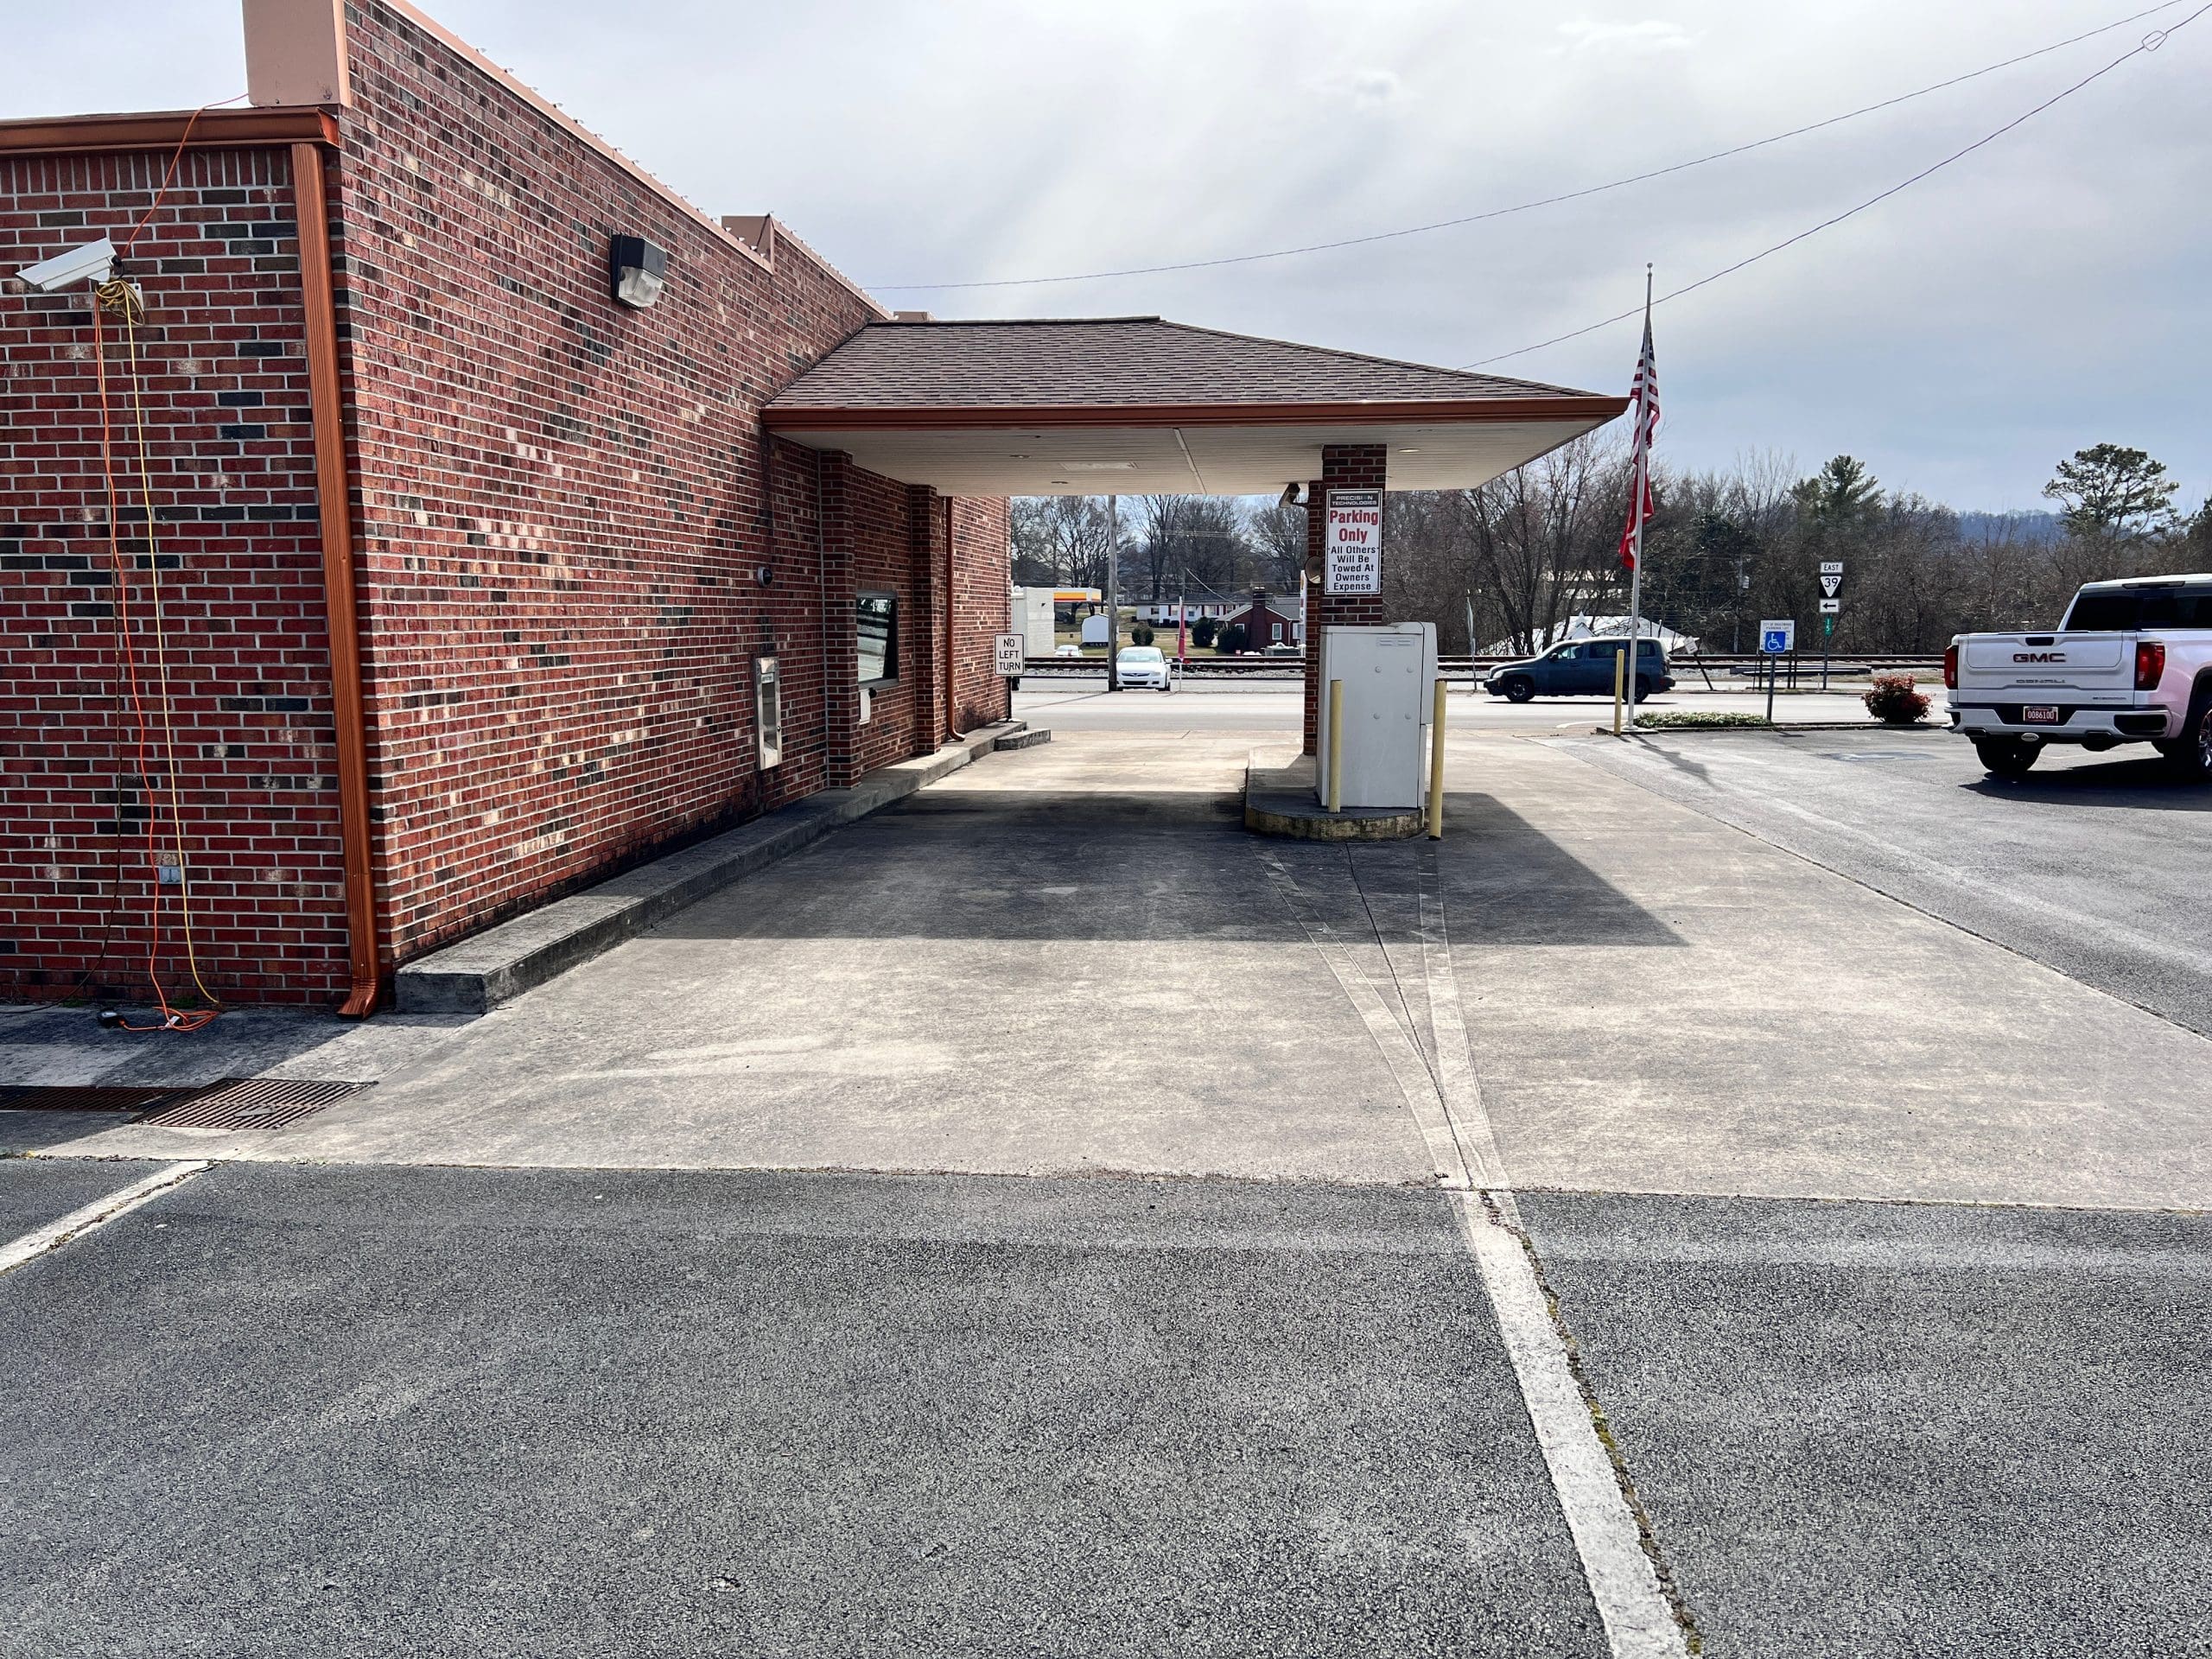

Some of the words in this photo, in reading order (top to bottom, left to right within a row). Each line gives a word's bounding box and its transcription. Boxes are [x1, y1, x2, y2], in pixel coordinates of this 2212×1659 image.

[1330, 510, 1378, 525] Parking
[1339, 528, 1368, 543] Only
[1346, 545, 1376, 554] Others
[1335, 573, 1370, 582] Owners
[1333, 582, 1371, 591] Expense
[1825, 577, 1838, 588] 39
[1003, 638, 1015, 647] NO
[999, 650, 1019, 659] LEFT
[2013, 653, 2066, 663] GMC
[999, 661, 1020, 671] TURN
